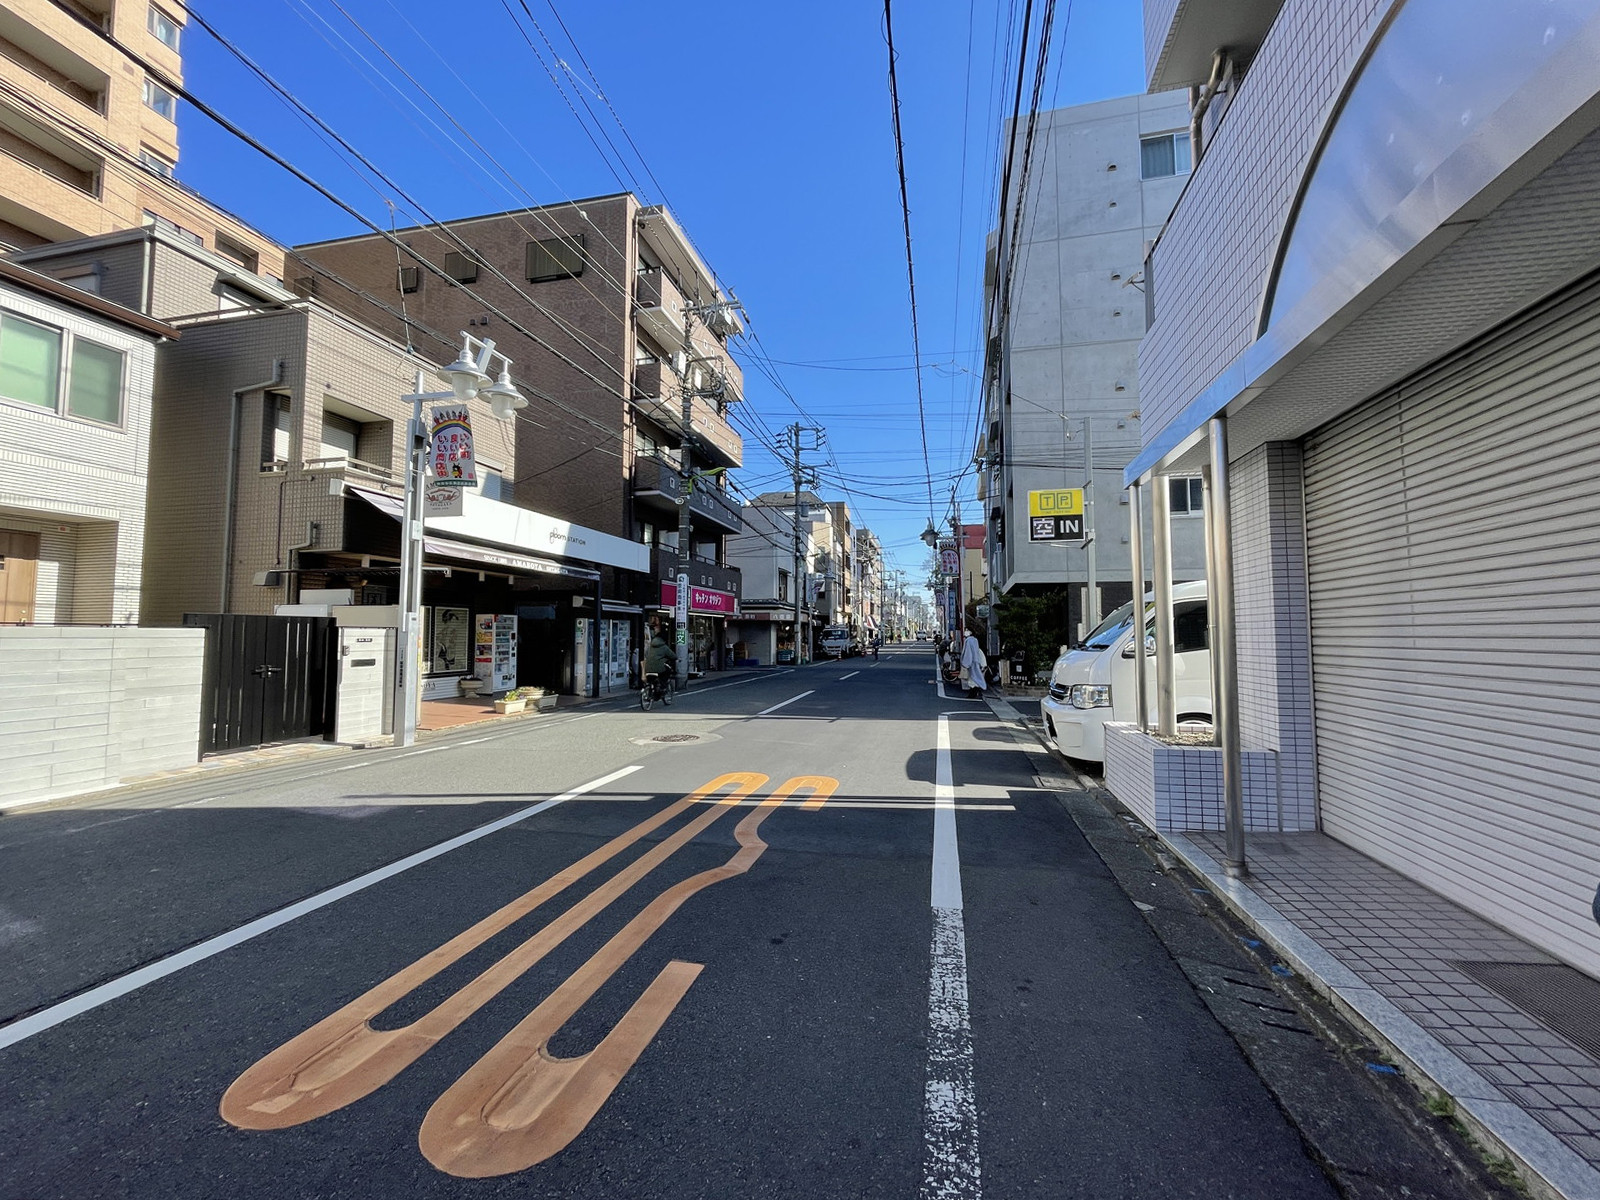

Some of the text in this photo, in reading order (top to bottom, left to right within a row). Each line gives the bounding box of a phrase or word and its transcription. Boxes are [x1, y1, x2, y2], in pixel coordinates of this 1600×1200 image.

[1033, 517, 1054, 538] 空
[1060, 520, 1079, 533] IN
[549, 527, 586, 546] ploom STATION
